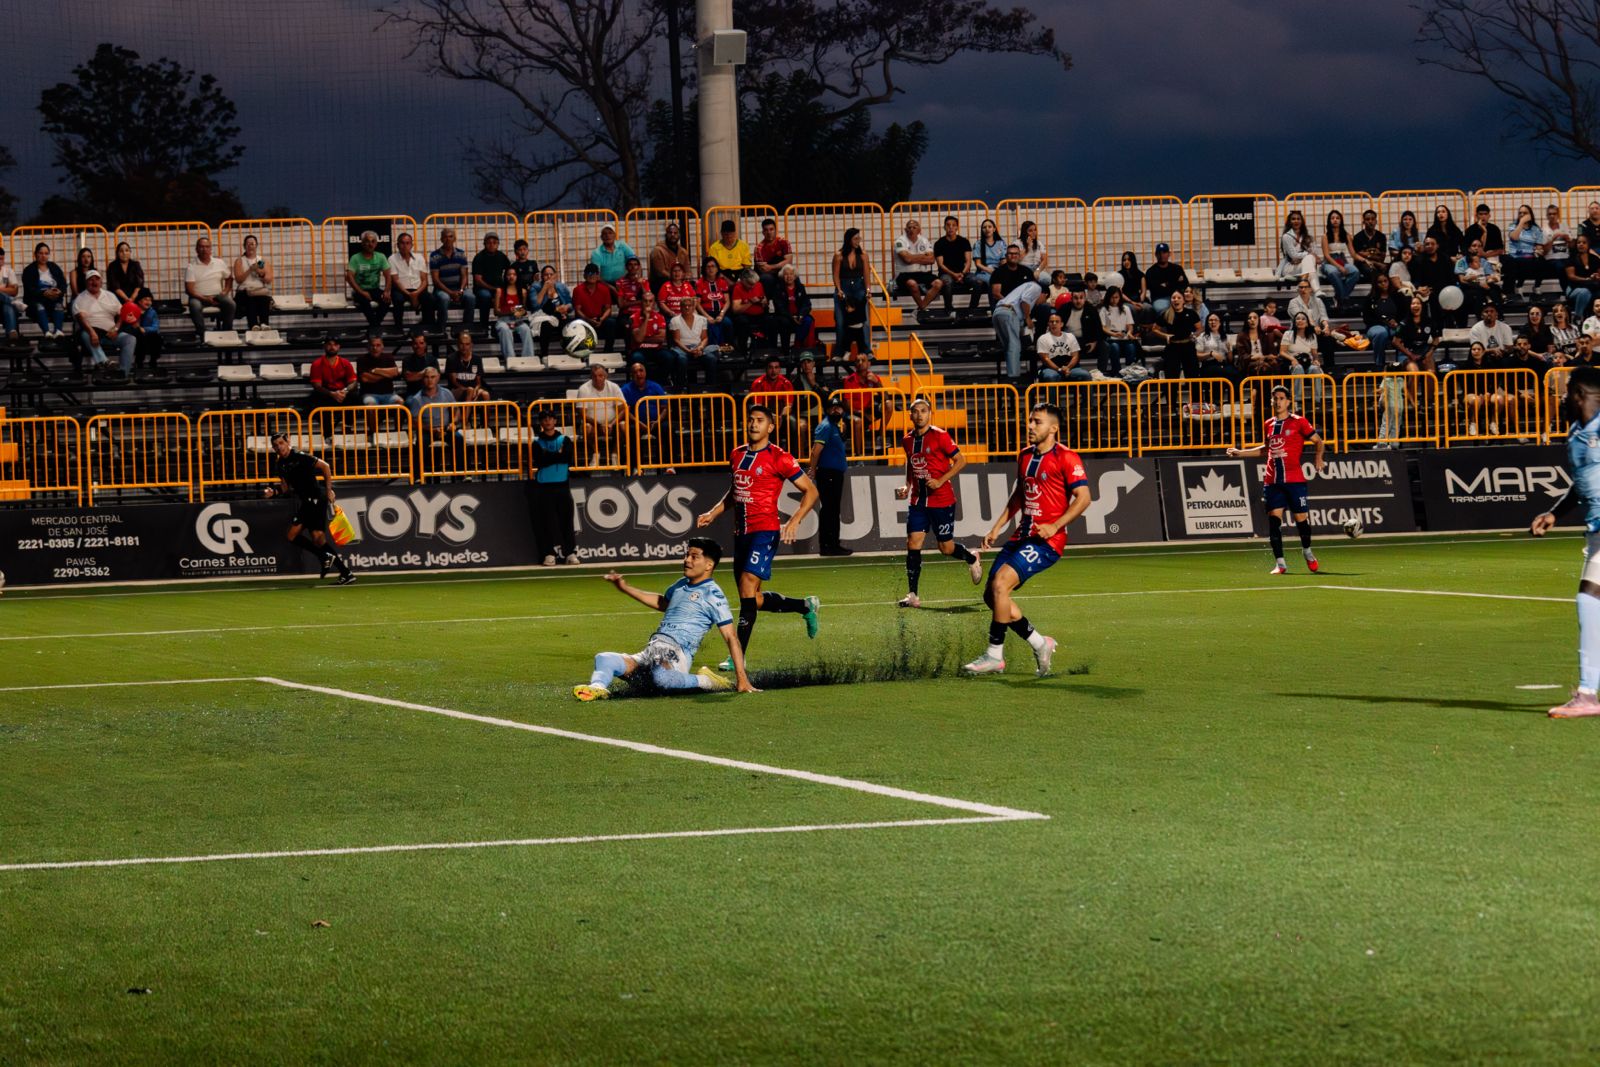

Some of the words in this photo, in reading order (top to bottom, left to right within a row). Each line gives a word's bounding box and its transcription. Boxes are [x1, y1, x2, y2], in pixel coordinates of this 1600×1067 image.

[1215, 213, 1252, 221] BLOQUE
[350, 235, 390, 243] BLUE
[734, 474, 752, 485] CLK
[1449, 494, 1527, 503] TRANSPORTES
[31, 516, 78, 526] MERCADO
[80, 515, 122, 524] CENTRAL
[335, 489, 481, 543] TOYS
[48, 528, 61, 536] DE
[63, 528, 83, 536] SAN
[85, 525, 108, 535] JOSÉ
[938, 523, 951, 535] 22
[1195, 520, 1243, 530] LUBRICANTS
[18, 539, 75, 550] 2221-0305
[84, 536, 140, 547] 2221-8181
[620, 542, 640, 557] de
[1020, 545, 1039, 563] 20
[66, 557, 96, 566] PAVAS
[180, 557, 225, 568] Carnes
[229, 555, 277, 567] Retana
[349, 552, 399, 567] tienda
[401, 551, 422, 565] de
[424, 548, 489, 567] juguetes
[750, 551, 760, 564] 5
[53, 567, 110, 578] 2290-5362
